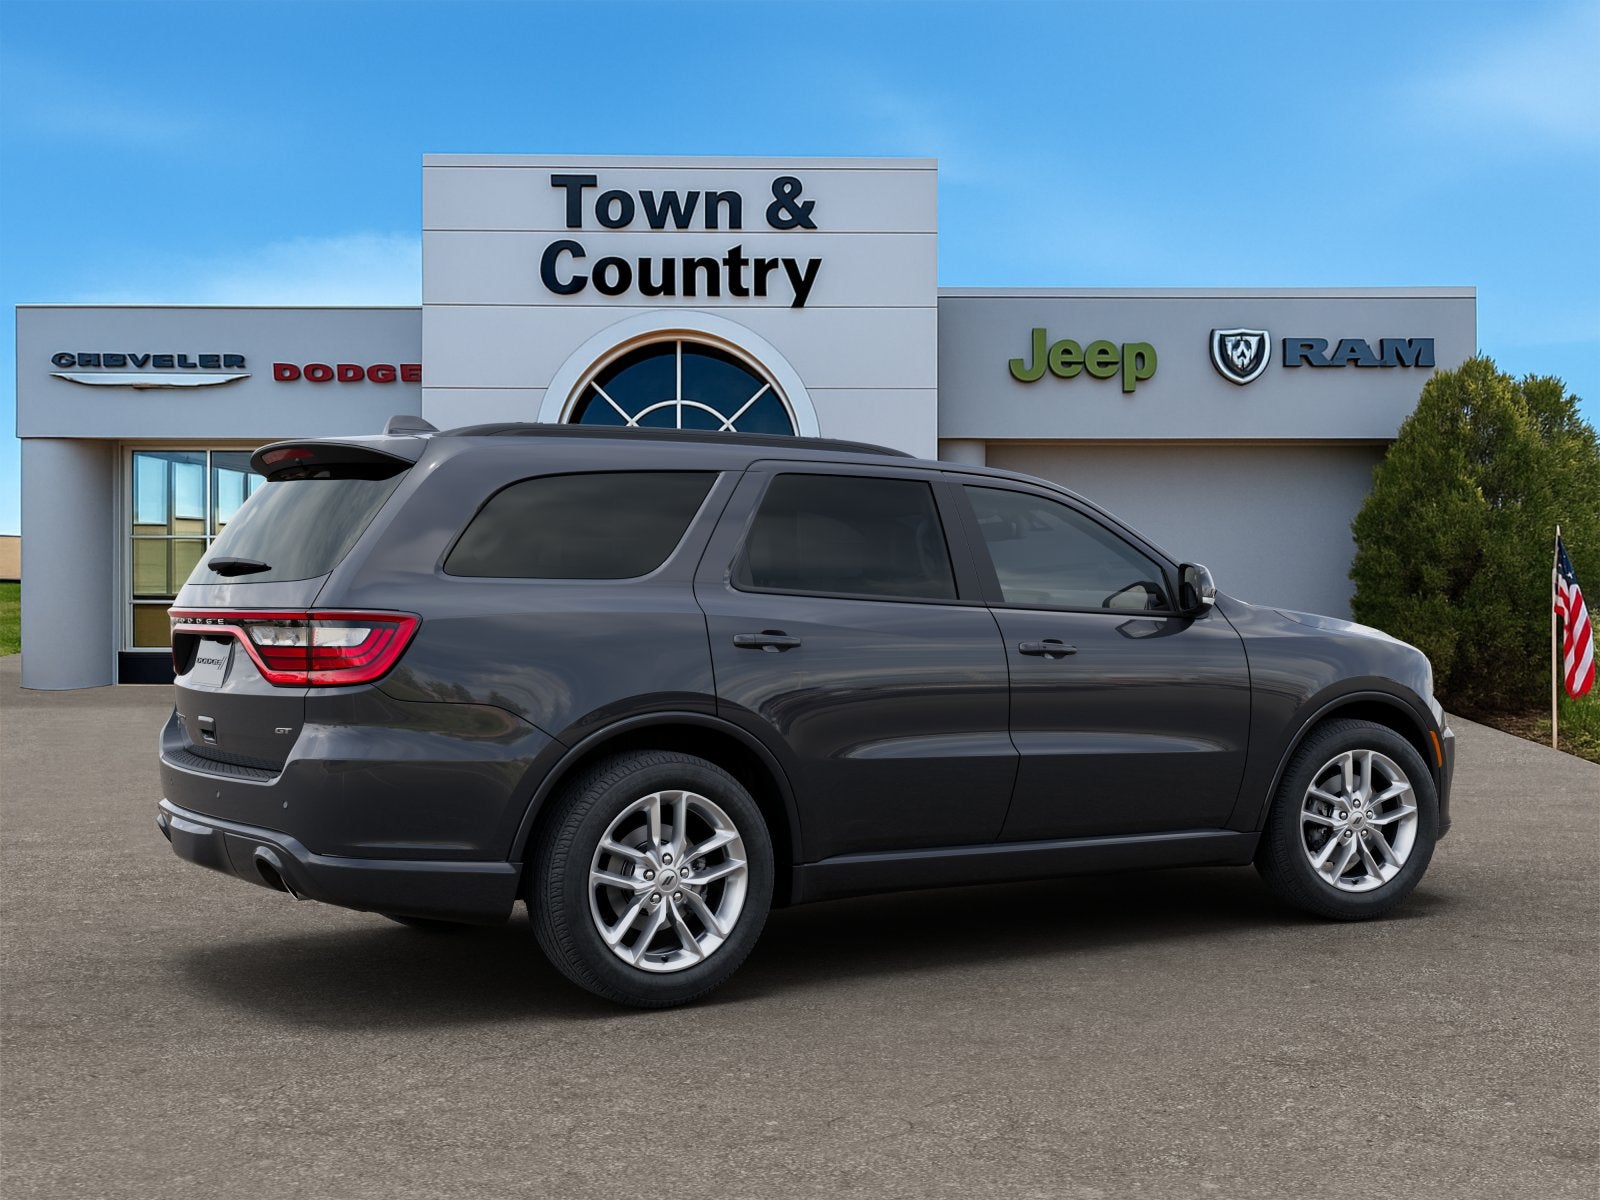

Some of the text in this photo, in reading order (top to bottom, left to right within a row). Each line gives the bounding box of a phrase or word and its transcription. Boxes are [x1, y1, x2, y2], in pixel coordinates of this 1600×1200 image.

[550, 174, 818, 230] Town &
[540, 239, 823, 308] Country
[273, 363, 422, 383] DODGE
[1009, 328, 1157, 392] Jeep
[1282, 337, 1435, 368] RAM
[275, 727, 293, 735] GT
